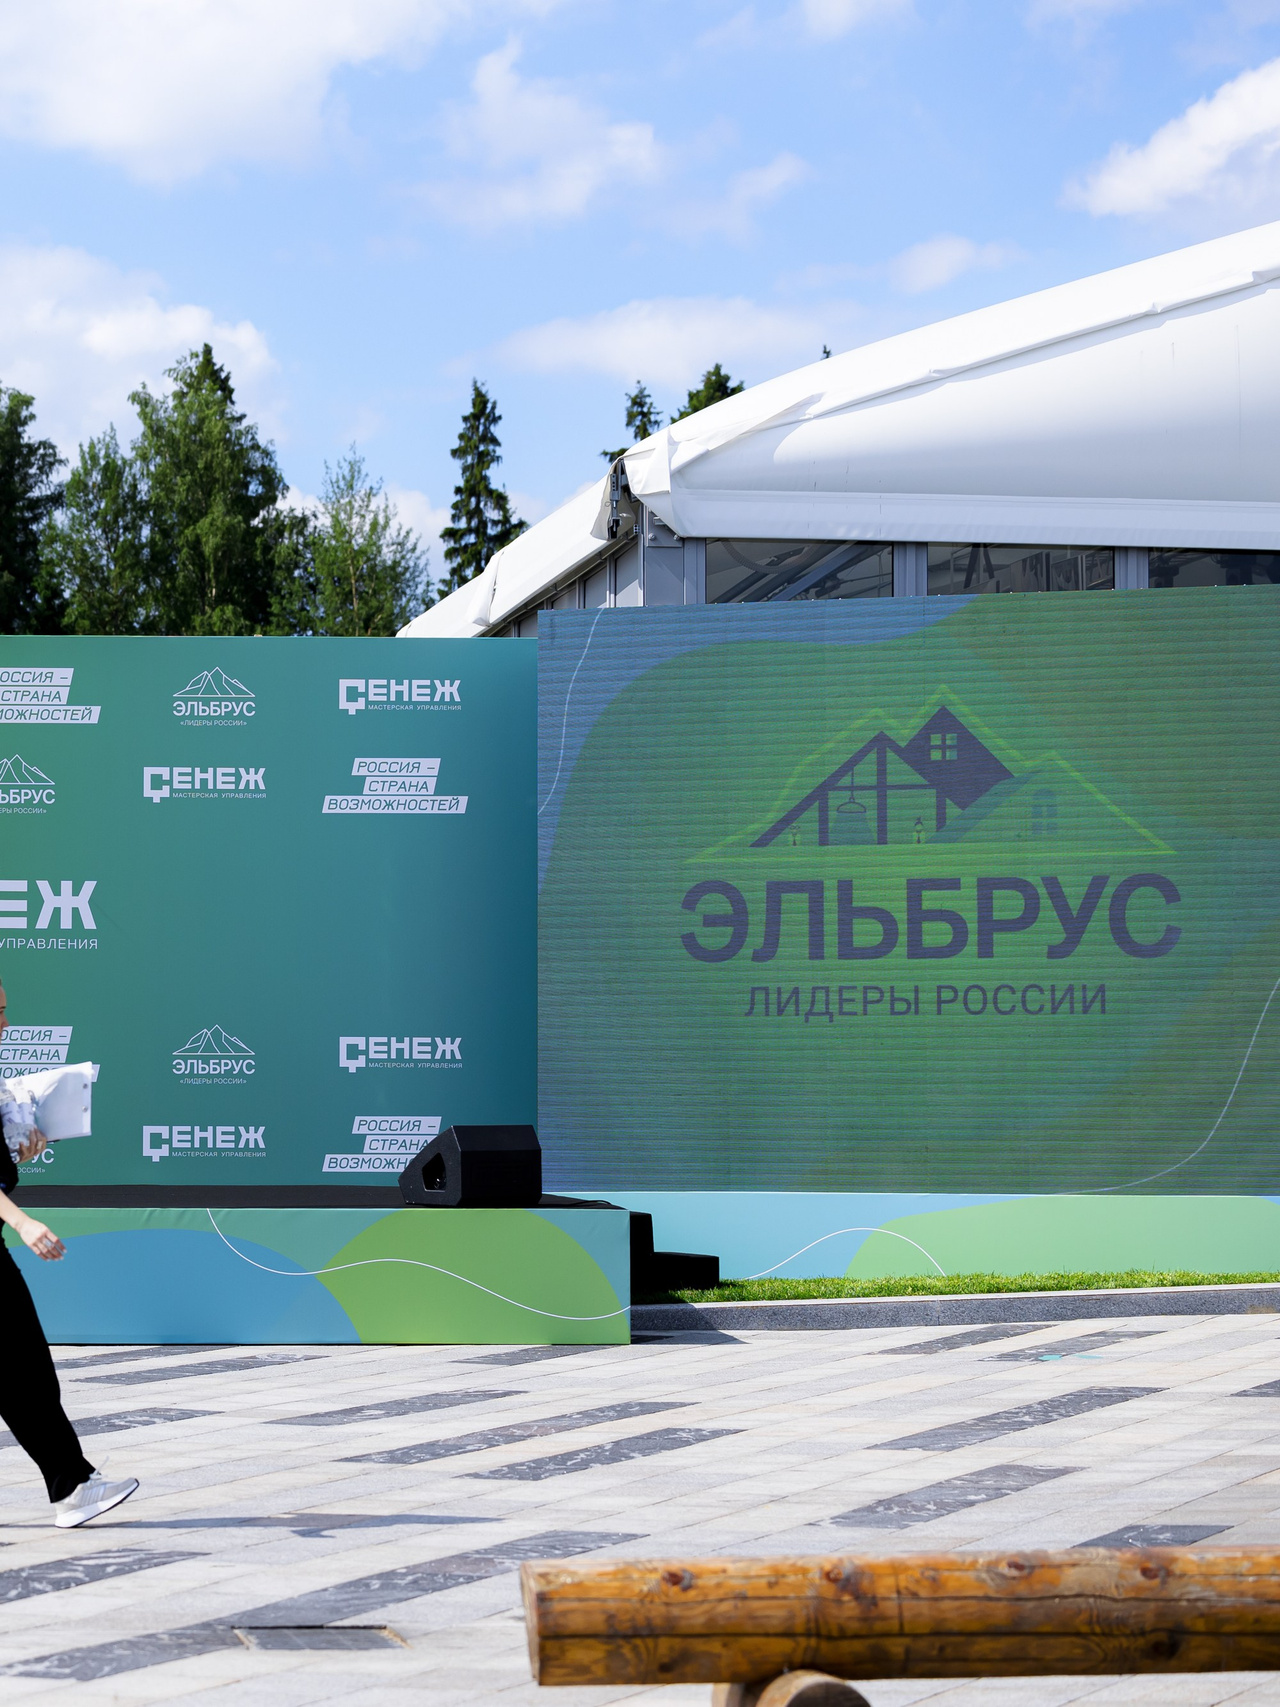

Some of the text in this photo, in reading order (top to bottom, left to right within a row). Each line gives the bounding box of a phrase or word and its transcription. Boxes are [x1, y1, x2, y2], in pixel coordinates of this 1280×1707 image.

[1, 690, 61, 702] СТРАНА
[173, 701, 255, 716] ЭЛЬБРУС
[180, 719, 247, 727] «ЛИДЕРЫ РОССИИ»
[357, 762, 421, 773] РОССИЯ
[369, 781, 428, 792] СТРАНА
[328, 797, 459, 810] ВОЗМОЖНОСТЕЙ
[14, 807, 46, 815] РОССИИ»
[680, 872, 1183, 964] ЭЛЬБРУС
[744, 983, 1108, 1023] ЛИДЕРЫ РОССИИ
[1, 1029, 53, 1042] ОССИЯ
[0, 1048, 61, 1061] СТРАНА
[173, 1059, 255, 1074] ЭЛЬБРУС
[369, 1061, 414, 1069] МАСТЕРСКАЯ
[180, 1077, 246, 1085] «ЛИДЕРЫ РОССИИ»
[358, 1120, 421, 1131] РОССИЯ
[17, 1166, 46, 1174] ОССИИ»
